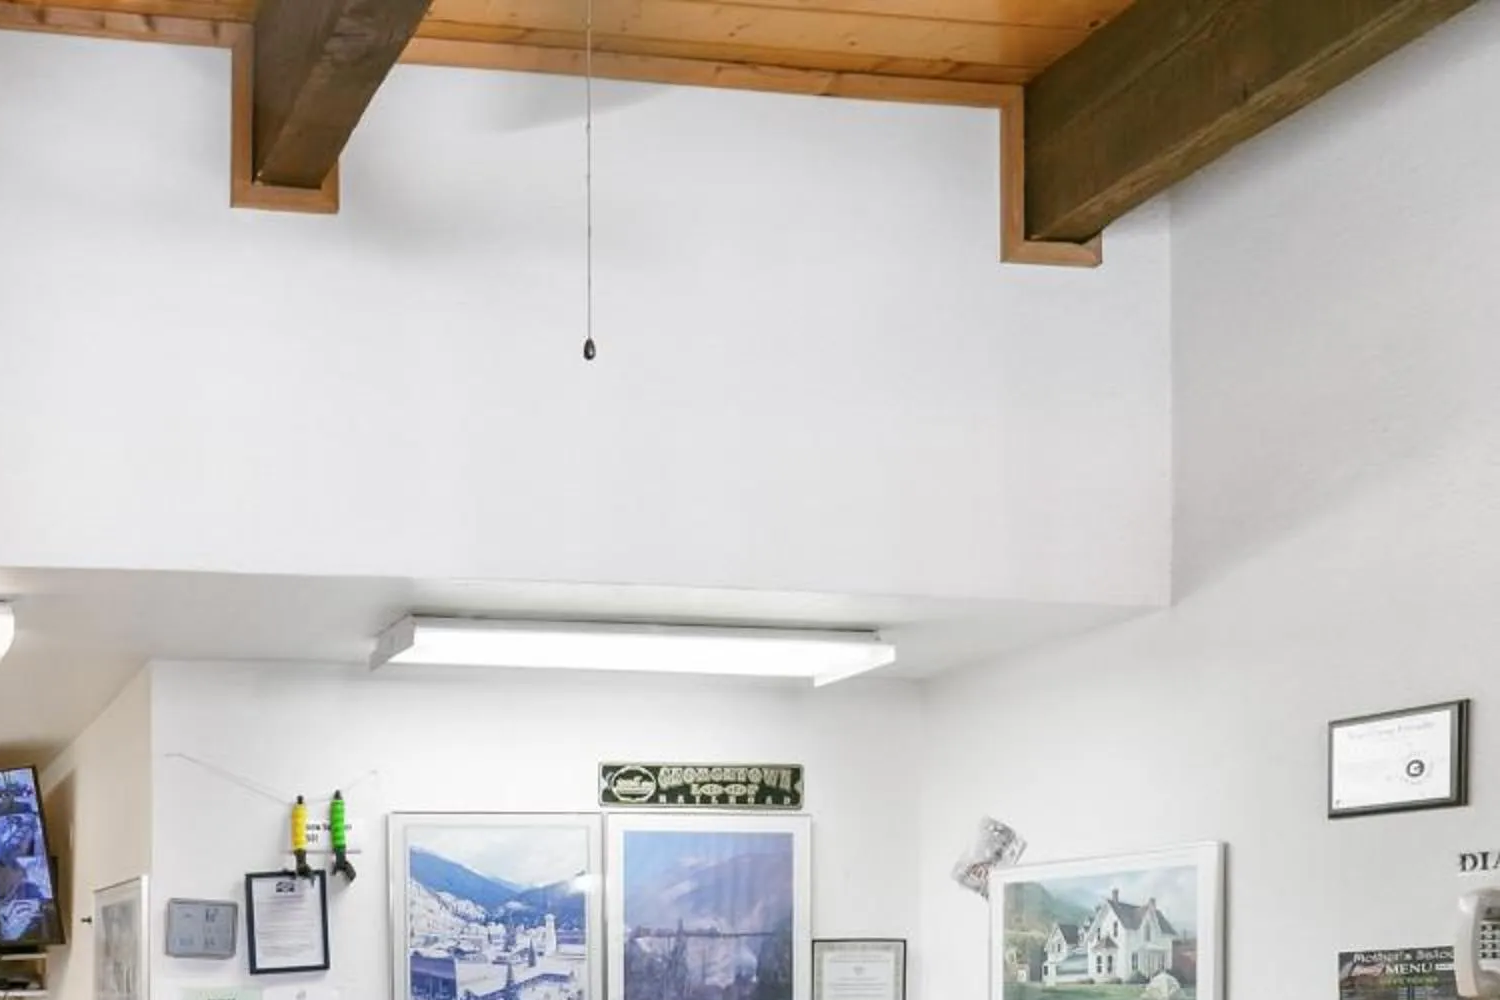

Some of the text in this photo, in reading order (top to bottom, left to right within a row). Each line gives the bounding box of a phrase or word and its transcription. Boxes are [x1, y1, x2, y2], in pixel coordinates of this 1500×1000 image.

[658, 765, 792, 791] GEORGETOWN
[691, 783, 759, 797] LOOP
[1386, 963, 1433, 974] MENU
